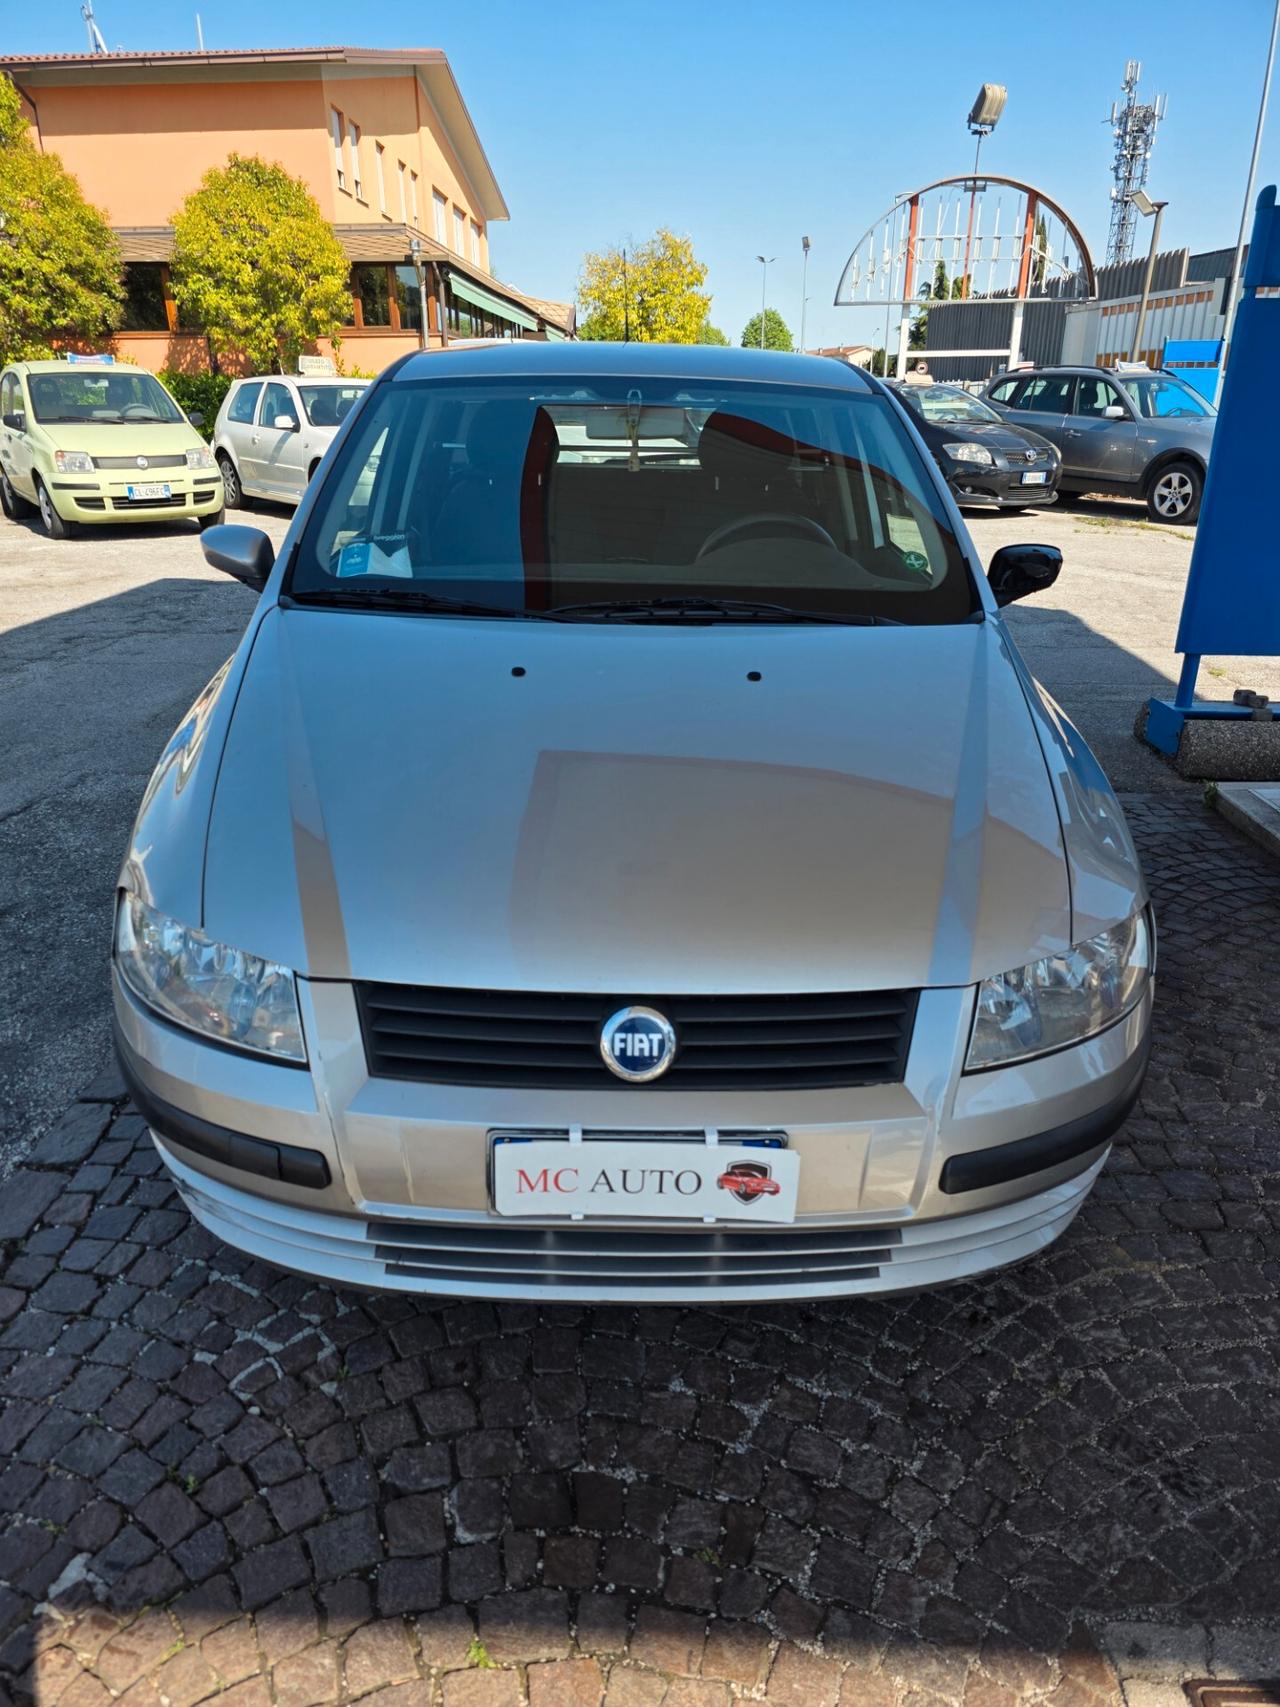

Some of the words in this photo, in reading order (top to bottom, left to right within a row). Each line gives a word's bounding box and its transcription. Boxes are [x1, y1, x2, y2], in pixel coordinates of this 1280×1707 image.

[614, 1033, 663, 1056] FIAT
[515, 1168, 578, 1194] MC
[588, 1168, 702, 1195] AUTO
